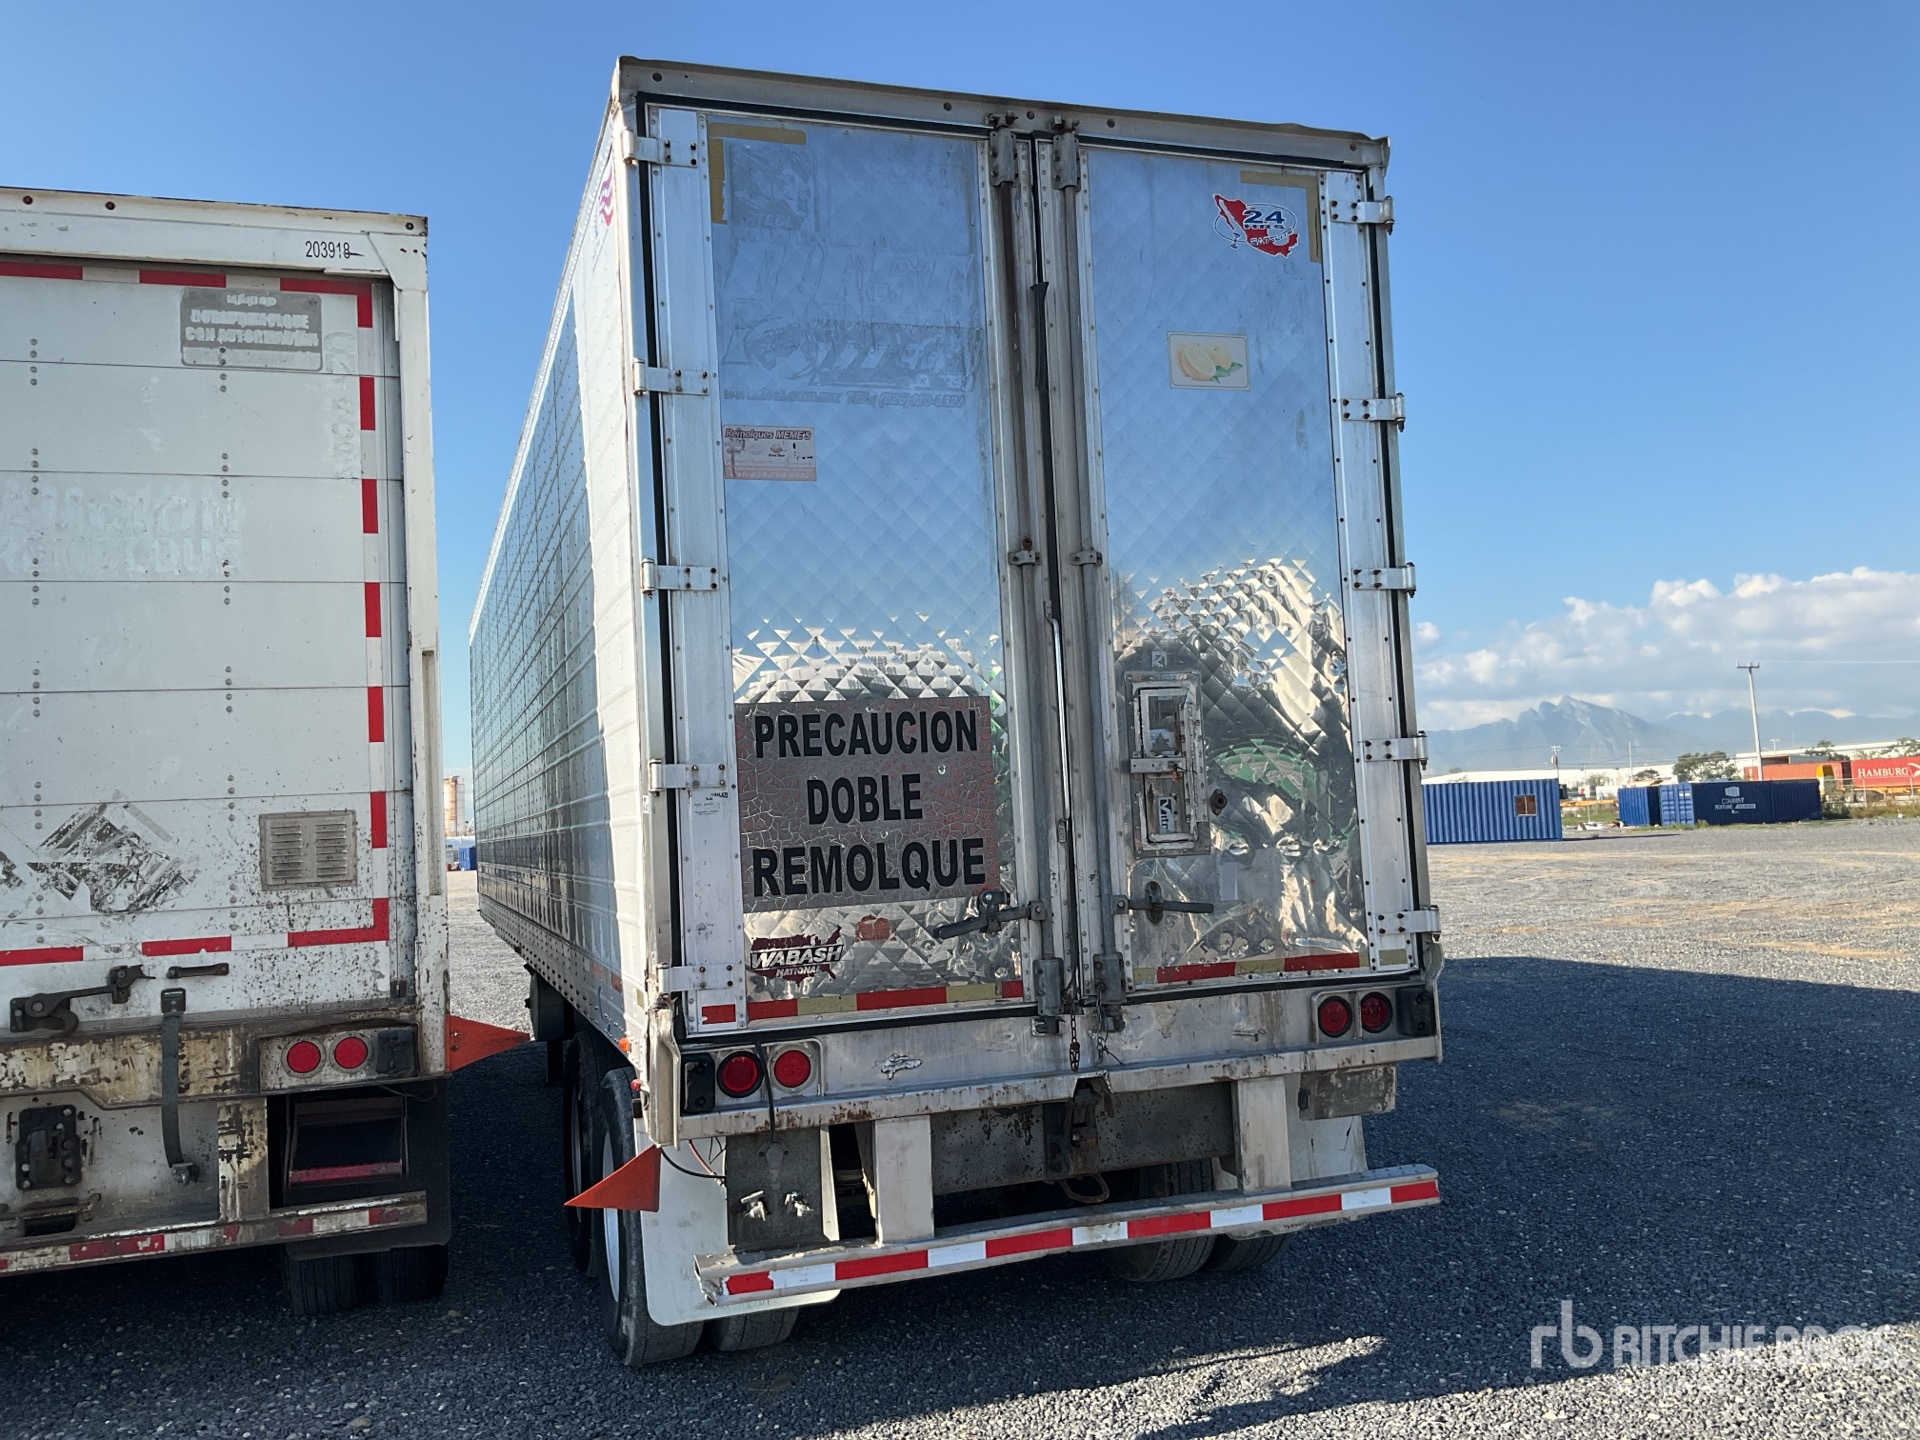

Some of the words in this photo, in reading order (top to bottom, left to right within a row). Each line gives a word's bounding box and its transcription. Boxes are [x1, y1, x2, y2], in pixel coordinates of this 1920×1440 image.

[1243, 210, 1285, 224] 24
[305, 240, 350, 259] 203918
[724, 428, 775, 442] Remolques
[775, 429, 812, 441] MEME'S
[755, 710, 978, 758] PRECAUCION
[1857, 767, 1909, 778] HAMBURG
[807, 773, 923, 825] DOBLE
[753, 838, 986, 898] REMOLQUE
[752, 945, 843, 969] WABASH
[776, 965, 821, 977] NATIONAL
